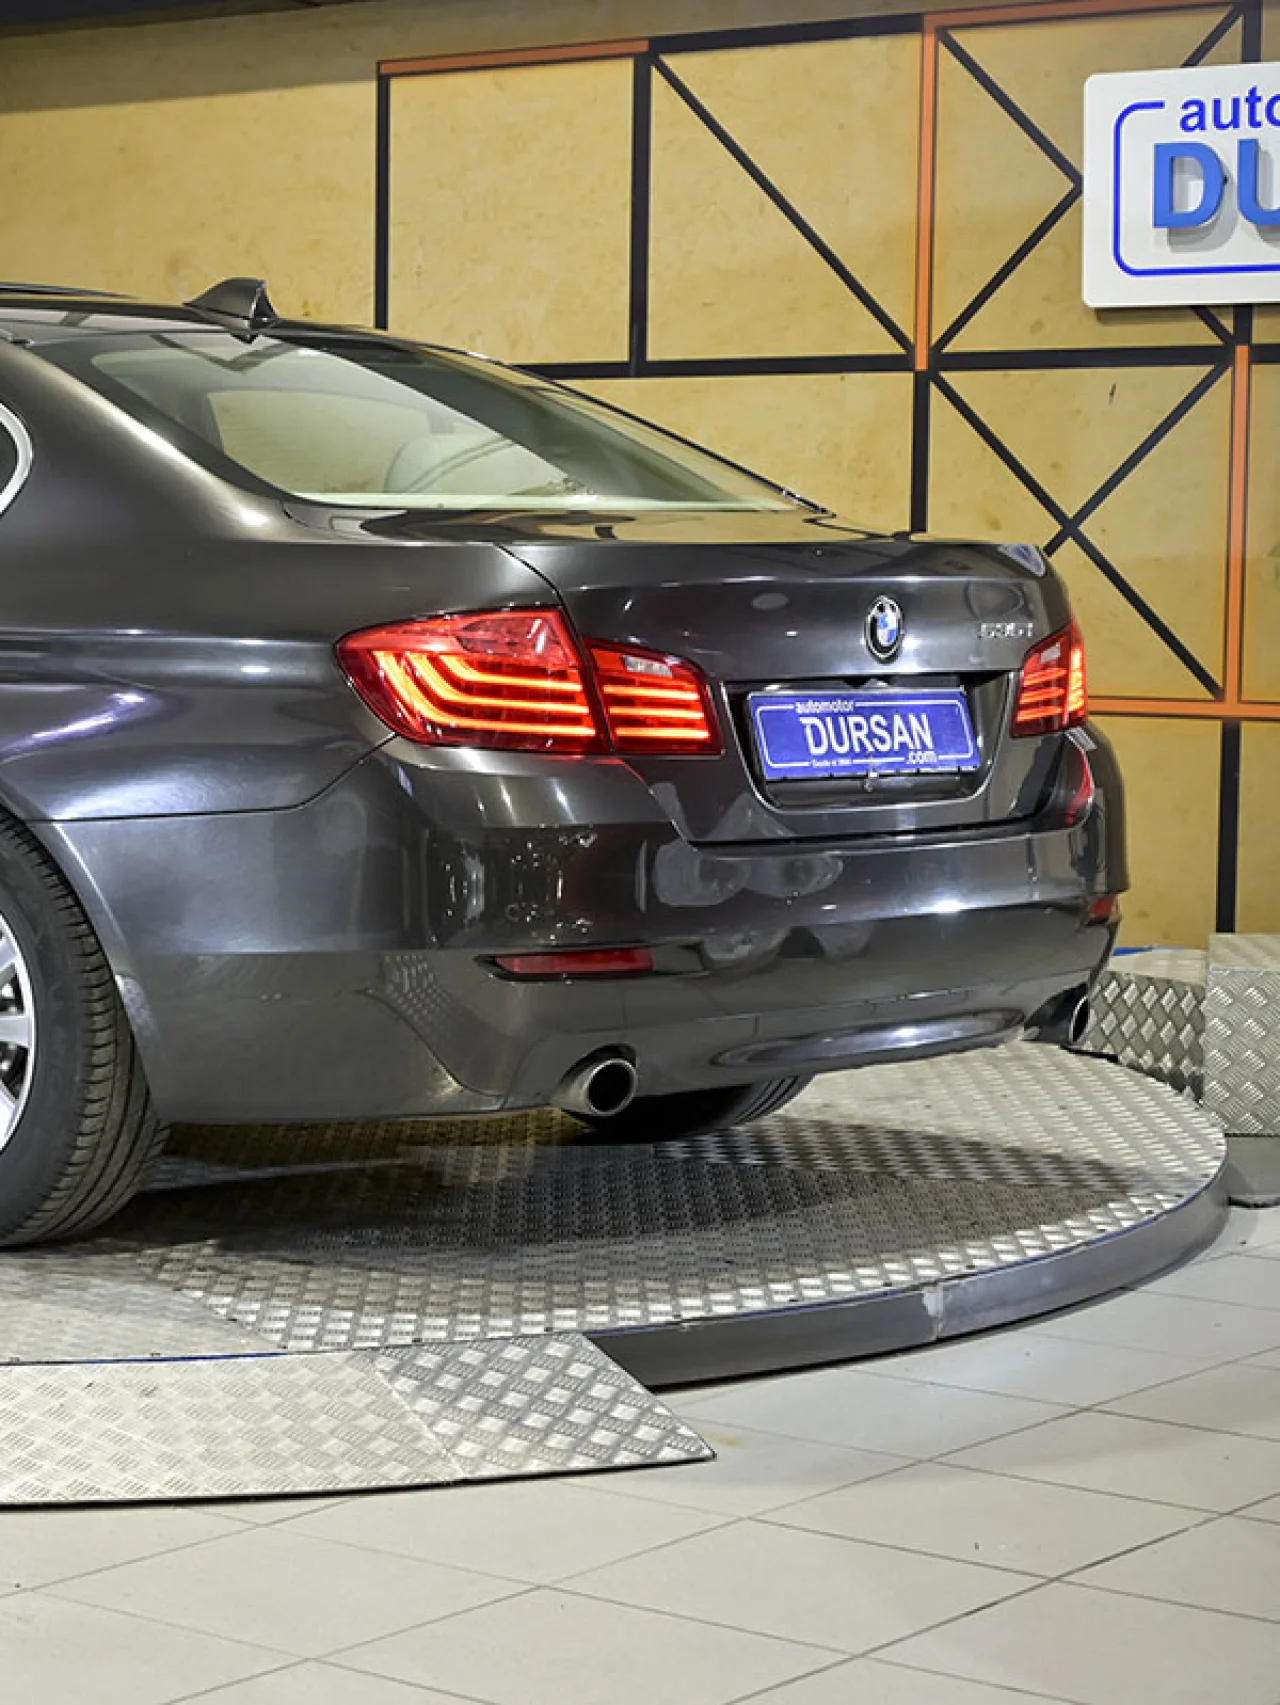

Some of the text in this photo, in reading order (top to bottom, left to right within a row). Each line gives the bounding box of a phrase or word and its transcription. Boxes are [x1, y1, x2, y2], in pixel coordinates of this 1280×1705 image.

[795, 700, 855, 713] automotor
[798, 712, 935, 756] DURSAN
[906, 750, 939, 765] .com
